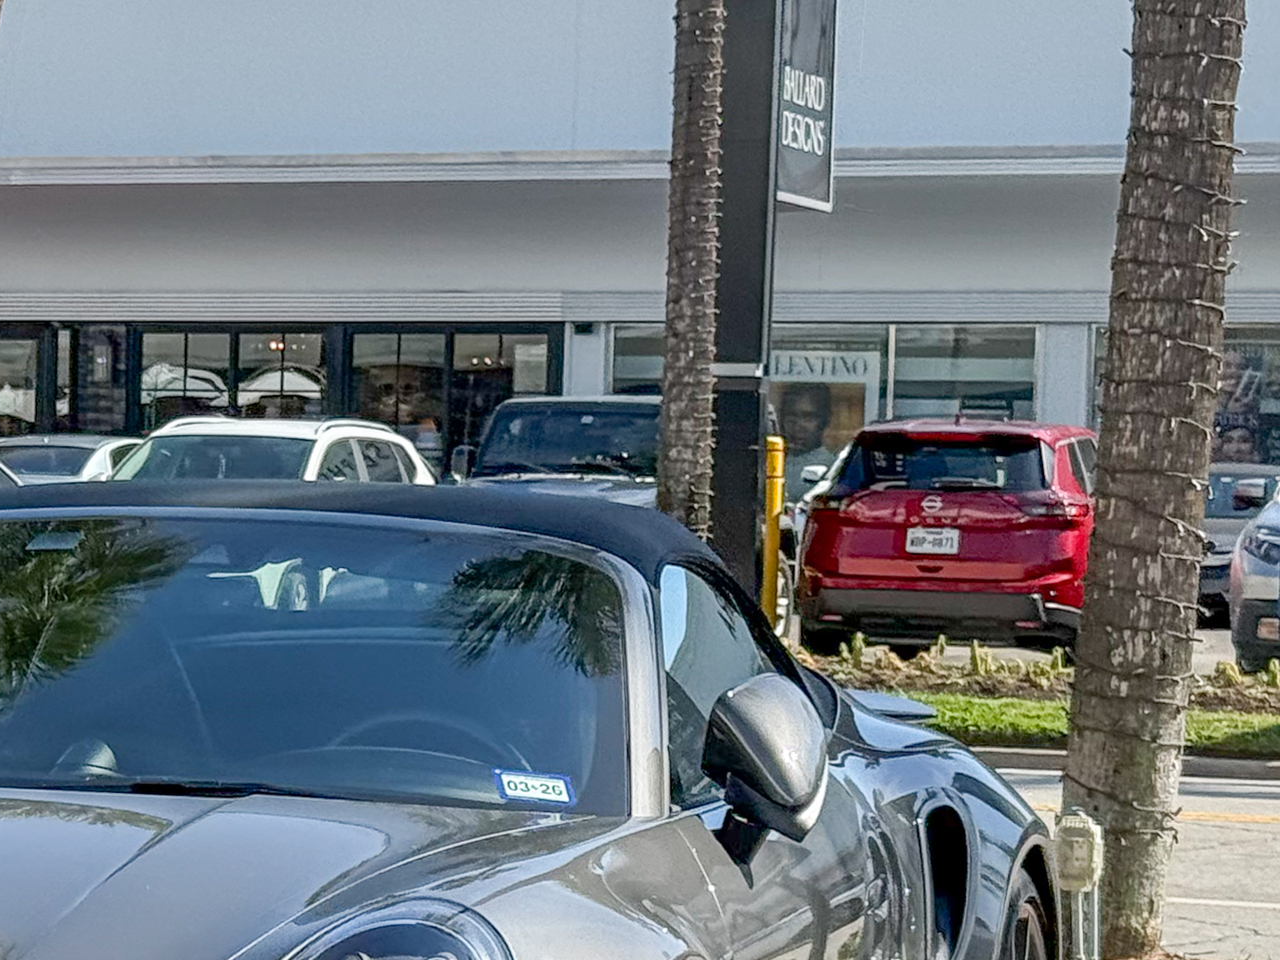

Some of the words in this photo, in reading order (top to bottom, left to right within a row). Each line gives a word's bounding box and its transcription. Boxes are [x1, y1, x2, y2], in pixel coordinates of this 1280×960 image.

[783, 65, 825, 112] BALLARD
[782, 110, 825, 156] DESIGNS
[506, 780, 563, 796] 03-26
